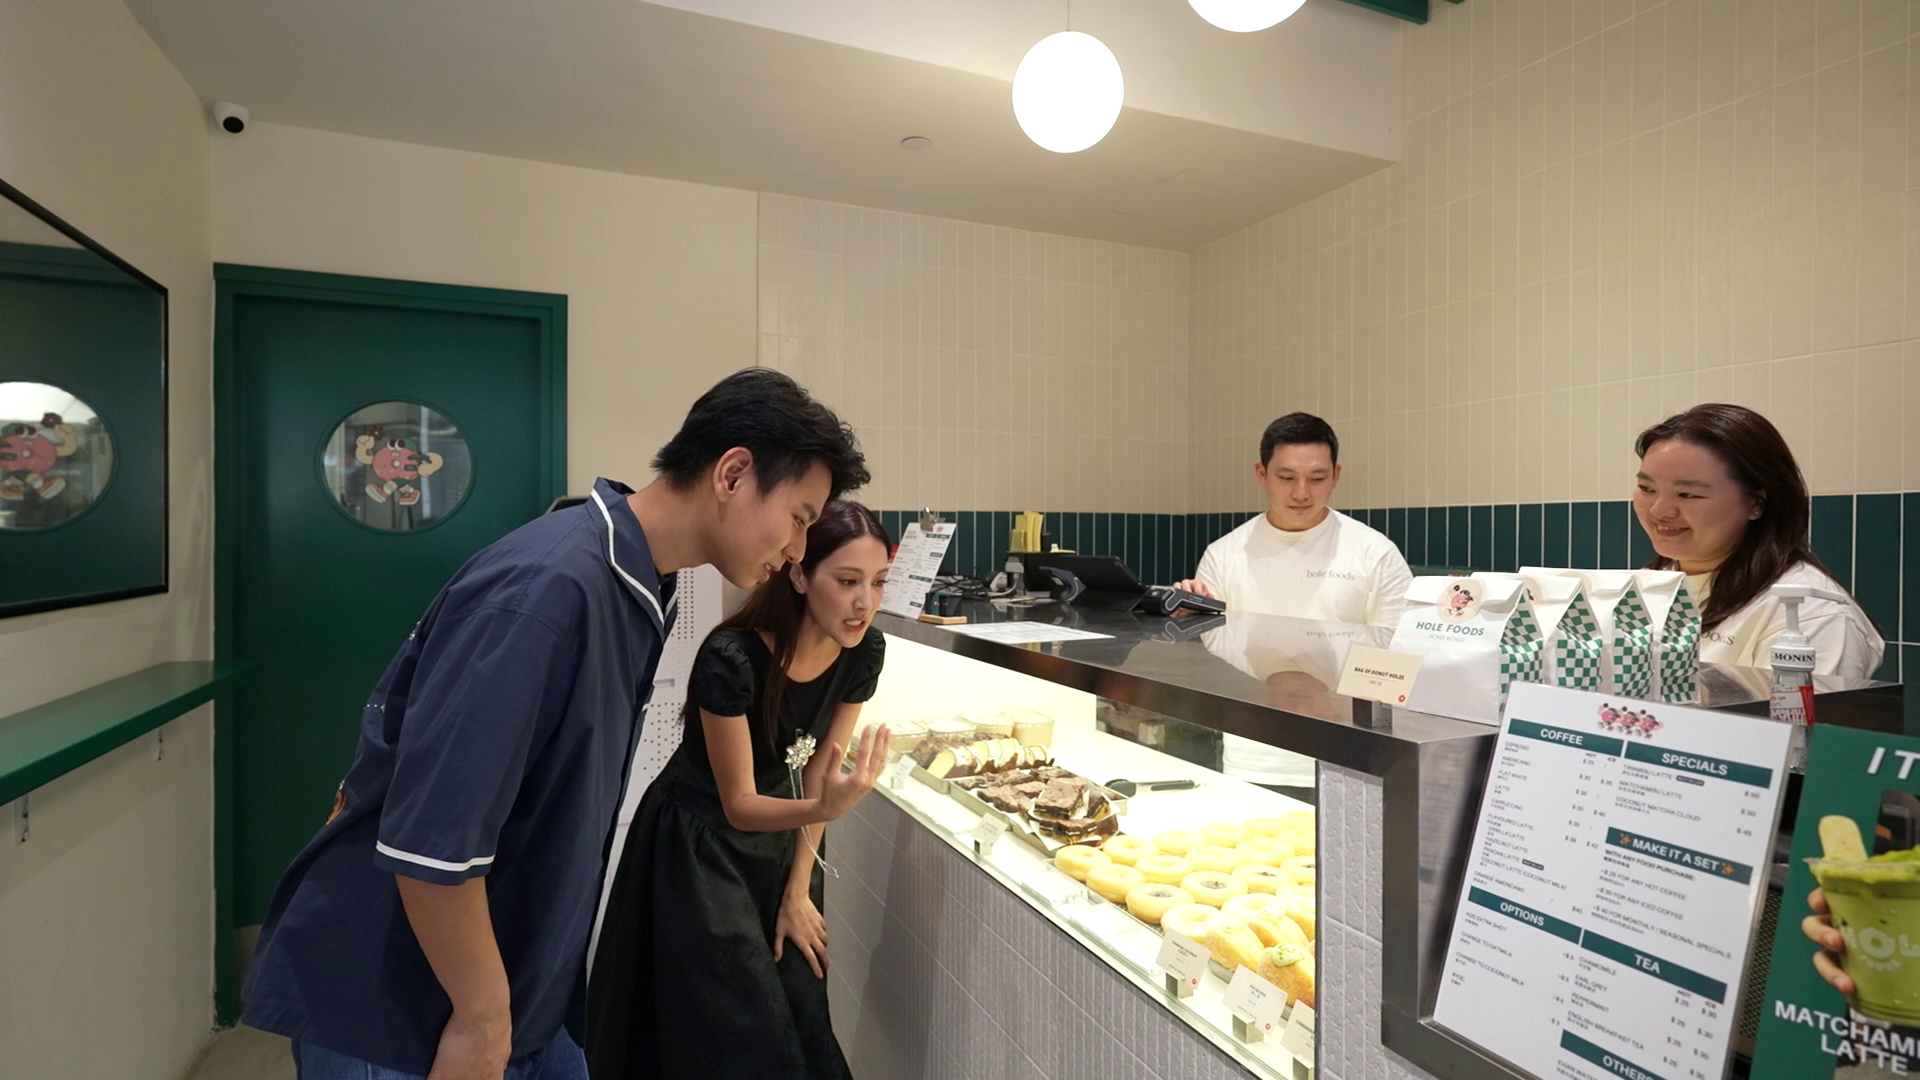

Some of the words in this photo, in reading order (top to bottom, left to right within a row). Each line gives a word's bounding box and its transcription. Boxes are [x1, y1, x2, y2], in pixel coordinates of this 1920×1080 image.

[1306, 570, 1326, 578] hole
[1328, 570, 1355, 580] foods
[1415, 621, 1442, 632] HOLE
[1446, 624, 1485, 636] FOODS
[1774, 653, 1813, 662] MONIN
[1540, 728, 1583, 745] COFFEE
[1505, 741, 1530, 751] ESPRESSO
[1502, 756, 1531, 766] AMERICANO
[1662, 753, 1728, 776] SPECIALS
[1511, 773, 1527, 781] WHITE
[1652, 770, 1672, 780] LATTE
[1495, 783, 1510, 792] LATTE
[1662, 790, 1682, 800] LATTE
[1491, 798, 1523, 811] CAPPUCCINO
[1615, 796, 1646, 809] COCONUT
[1648, 804, 1675, 816] MATCHA
[1676, 811, 1701, 822] CLOUD
[1488, 826, 1508, 836] VANILLA
[1509, 833, 1525, 841] LATTE
[1486, 836, 1511, 849] HAZELNUT
[1512, 844, 1528, 854] LATTE
[1484, 846, 1505, 857] PANDAN
[1506, 854, 1520, 863] LATTE
[1604, 849, 1621, 858] WITH
[1622, 854, 1635, 862] ANY
[1636, 858, 1655, 868] FOOD
[1632, 838, 1668, 857] MAKE
[1669, 848, 1682, 860] IT
[1682, 852, 1692, 863] A
[1694, 856, 1720, 871] SET
[1481, 856, 1505, 868] COCONUT
[1506, 866, 1522, 875] LATTE
[1495, 877, 1524, 893] AMERICANO
[1618, 873, 1630, 882] FOR
[1631, 876, 1644, 886] ANY
[1645, 881, 1659, 892] HOT
[1660, 885, 1686, 900] COFFEE
[1500, 902, 1545, 926] OPTIONS
[1613, 891, 1626, 900] FOR
[1627, 895, 1640, 905] ANY
[1641, 900, 1656, 910] ICED
[1657, 904, 1684, 920] COFFEE
[1478, 915, 1492, 926] EXTRA
[1493, 922, 1507, 932] SHOT
[1461, 931, 1481, 944] CHANGE
[1609, 910, 1622, 919] FOR
[1623, 915, 1655, 931] MONTHLY
[1659, 928, 1694, 946] SEASONAL
[1697, 942, 1731, 959] SPECIALS
[1456, 951, 1476, 965] CHANGE
[1478, 960, 1485, 968] TO
[1485, 964, 1510, 980] COCONUT
[1579, 956, 1616, 976] CHAMOMILE
[1634, 954, 1660, 974] TEA
[1575, 974, 1590, 985] EARL
[1591, 981, 1607, 992] GREY
[1572, 992, 1609, 1013] PEPPERMINT
[1568, 1010, 1594, 1027] ENGLISH
[1595, 1020, 1630, 1044] BREAKFAST
[1632, 1039, 1644, 1050] TEA
[1820, 1034, 1908, 1077] LATTE
